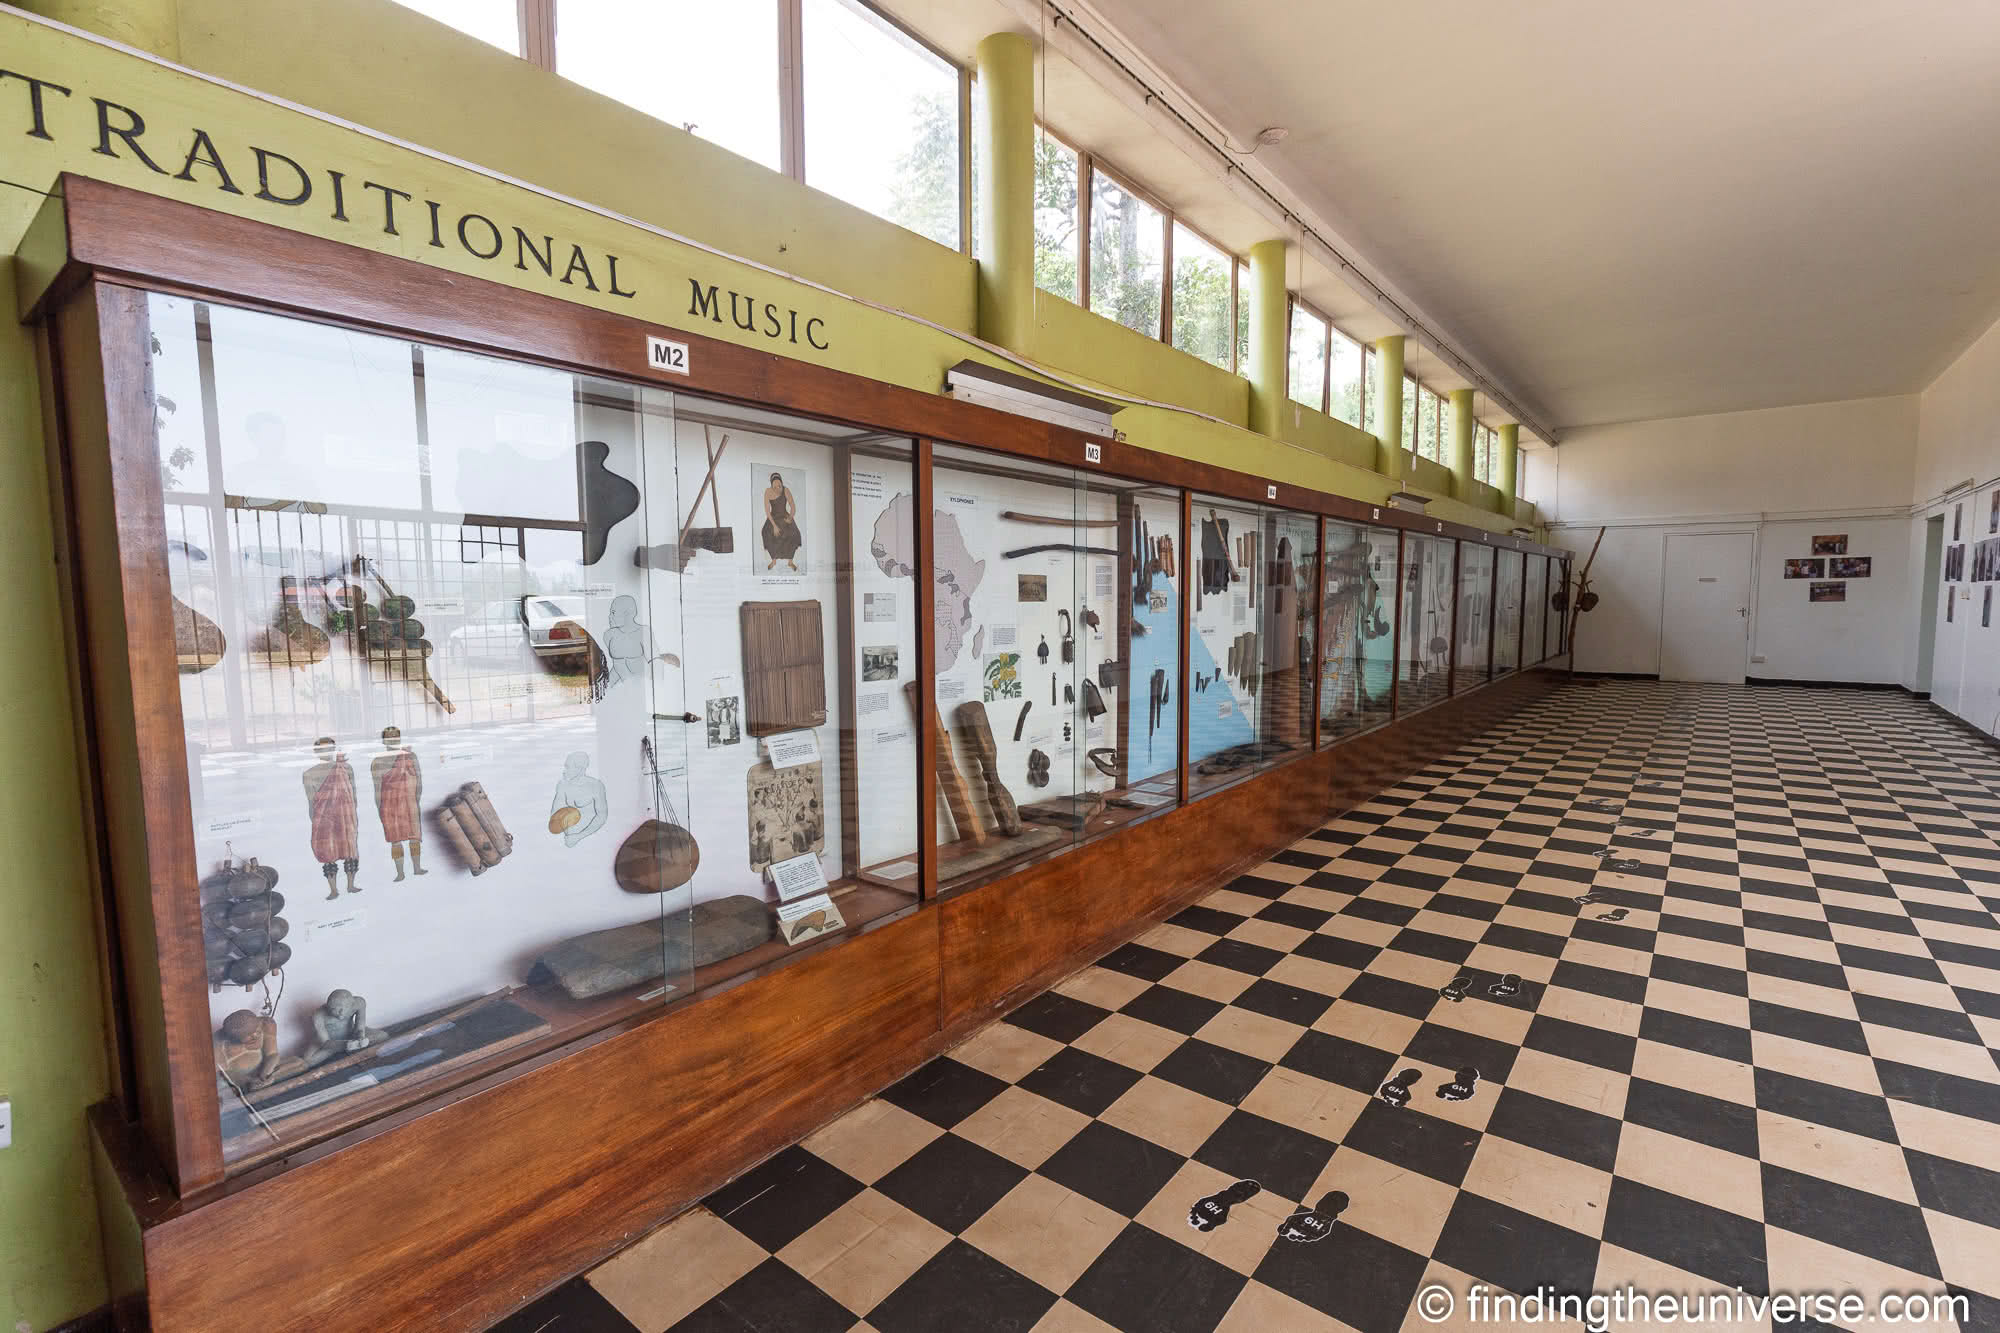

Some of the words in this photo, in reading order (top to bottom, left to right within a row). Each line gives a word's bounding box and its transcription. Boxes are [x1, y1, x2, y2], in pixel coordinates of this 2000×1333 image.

[0, 70, 636, 299] TRADITIONAL
[688, 279, 829, 350] MUSIC
[654, 344, 684, 367] M2
[1087, 447, 1100, 461] M3
[1204, 1201, 1223, 1215] 6H
[1304, 1216, 1324, 1230] 6H
